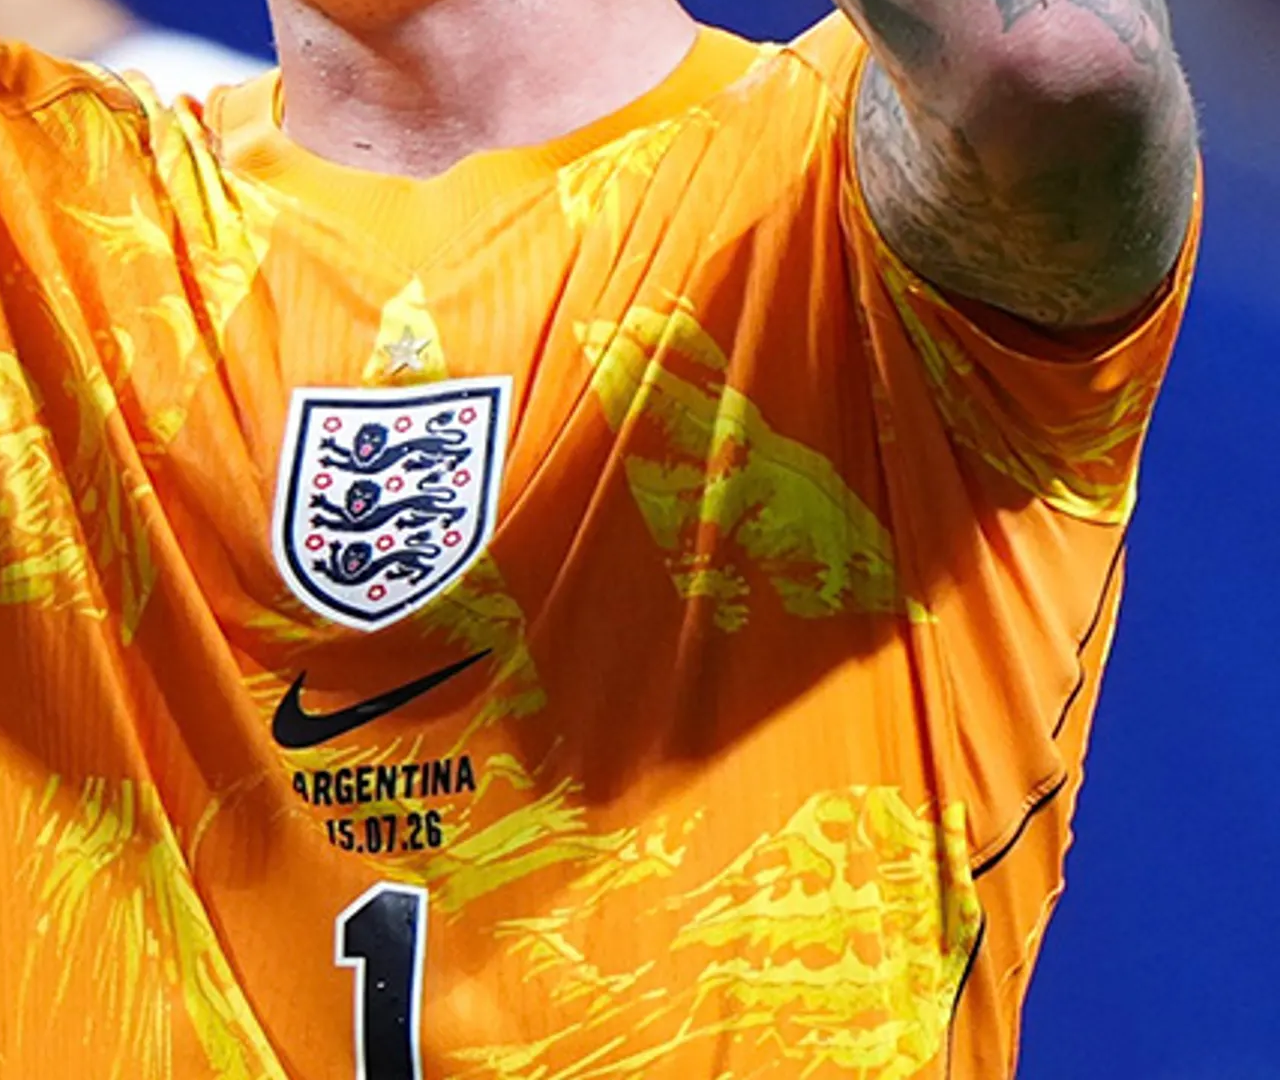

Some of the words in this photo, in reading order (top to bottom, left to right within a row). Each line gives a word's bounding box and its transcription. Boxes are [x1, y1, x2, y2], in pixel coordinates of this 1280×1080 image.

[292, 756, 476, 806] ARGENTINA
[326, 810, 443, 854] 15.07.26
[335, 879, 429, 1080] 1
